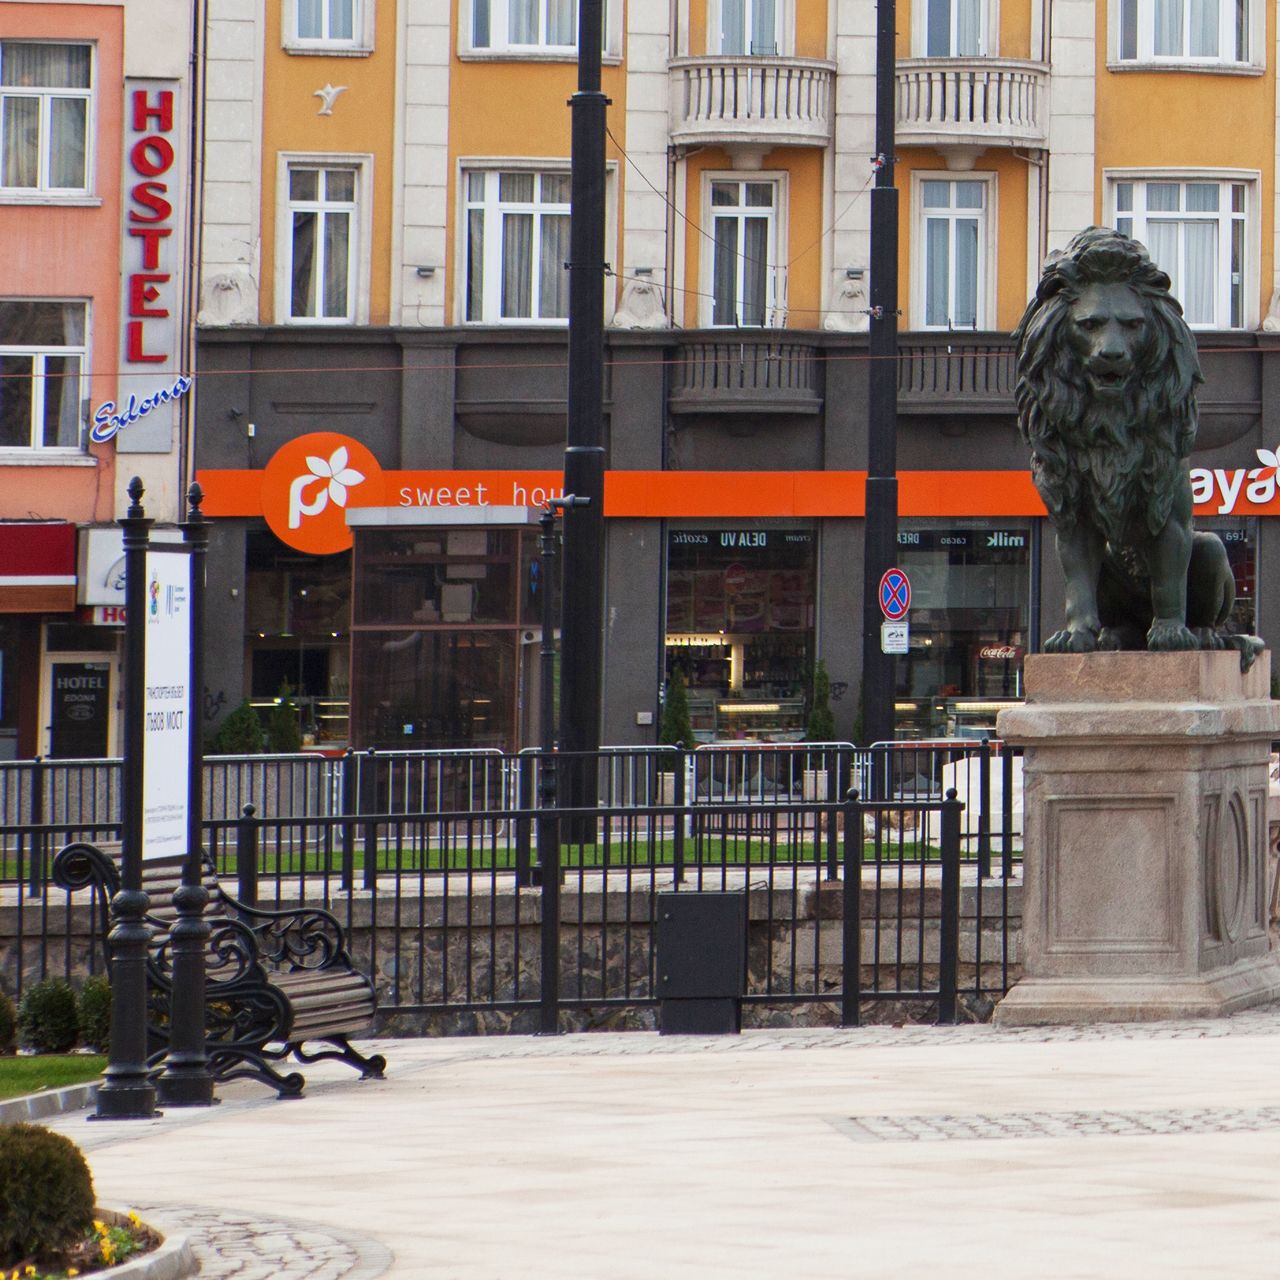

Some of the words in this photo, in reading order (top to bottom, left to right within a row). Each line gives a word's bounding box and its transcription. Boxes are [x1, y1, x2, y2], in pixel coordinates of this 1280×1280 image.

[127, 90, 175, 363] HOSTEL
[91, 377, 192, 442] Edona
[399, 483, 489, 507] sweet
[512, 481, 564, 507] hou
[1190, 468, 1276, 515] aya
[57, 676, 105, 689] HOTEL
